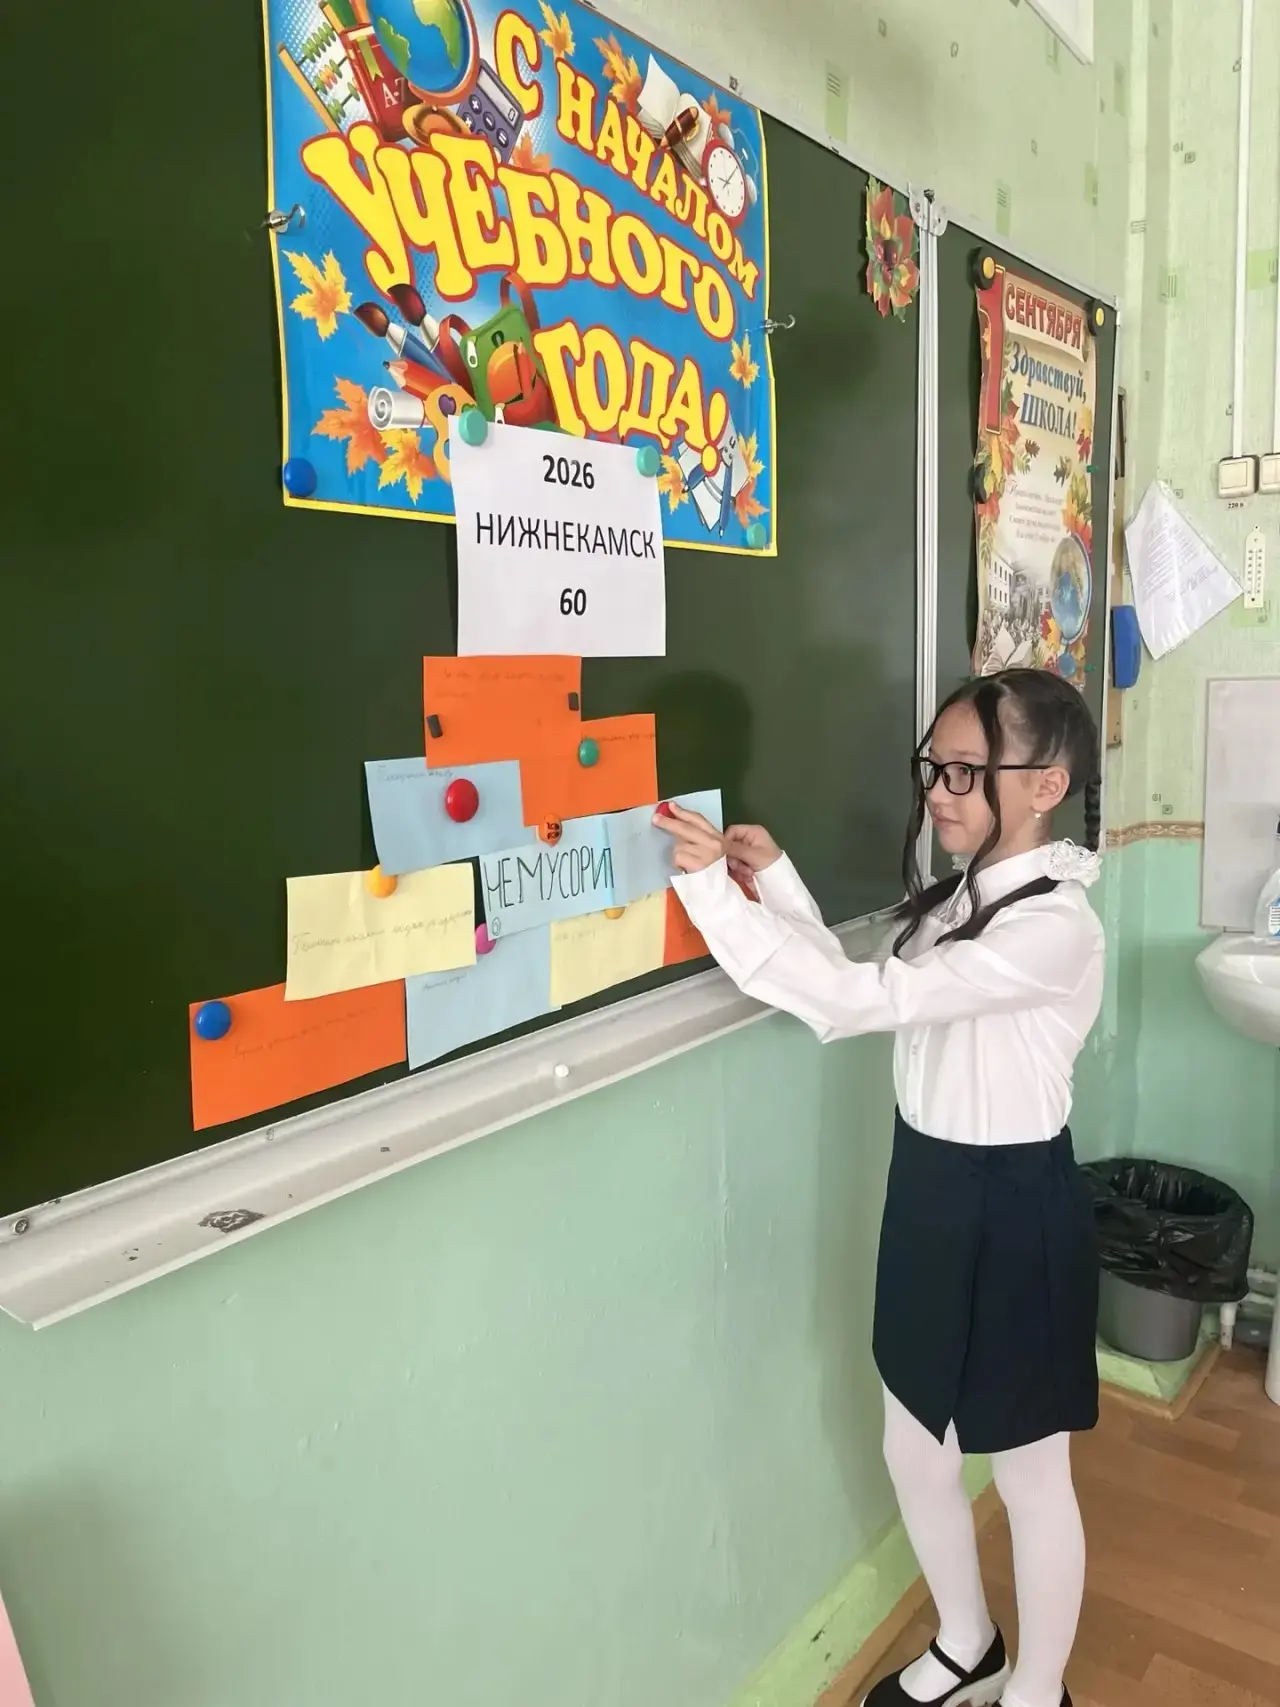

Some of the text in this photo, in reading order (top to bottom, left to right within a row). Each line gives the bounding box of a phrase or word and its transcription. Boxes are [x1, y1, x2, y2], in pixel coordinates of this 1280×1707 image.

[494, 10, 760, 300] С НАЧАЛОМ
[302, 121, 737, 342] УЧЕБНОГО
[1005, 283, 1082, 350] СЕНТЯБРЯ
[533, 319, 729, 478] ГОДА!
[1010, 341, 1086, 404] Здравствуй,
[1019, 392, 1077, 440] ШКОЛА!
[542, 454, 595, 490] 2026
[476, 512, 656, 559] НИЖНЕКАМСК
[559, 588, 587, 616] 60
